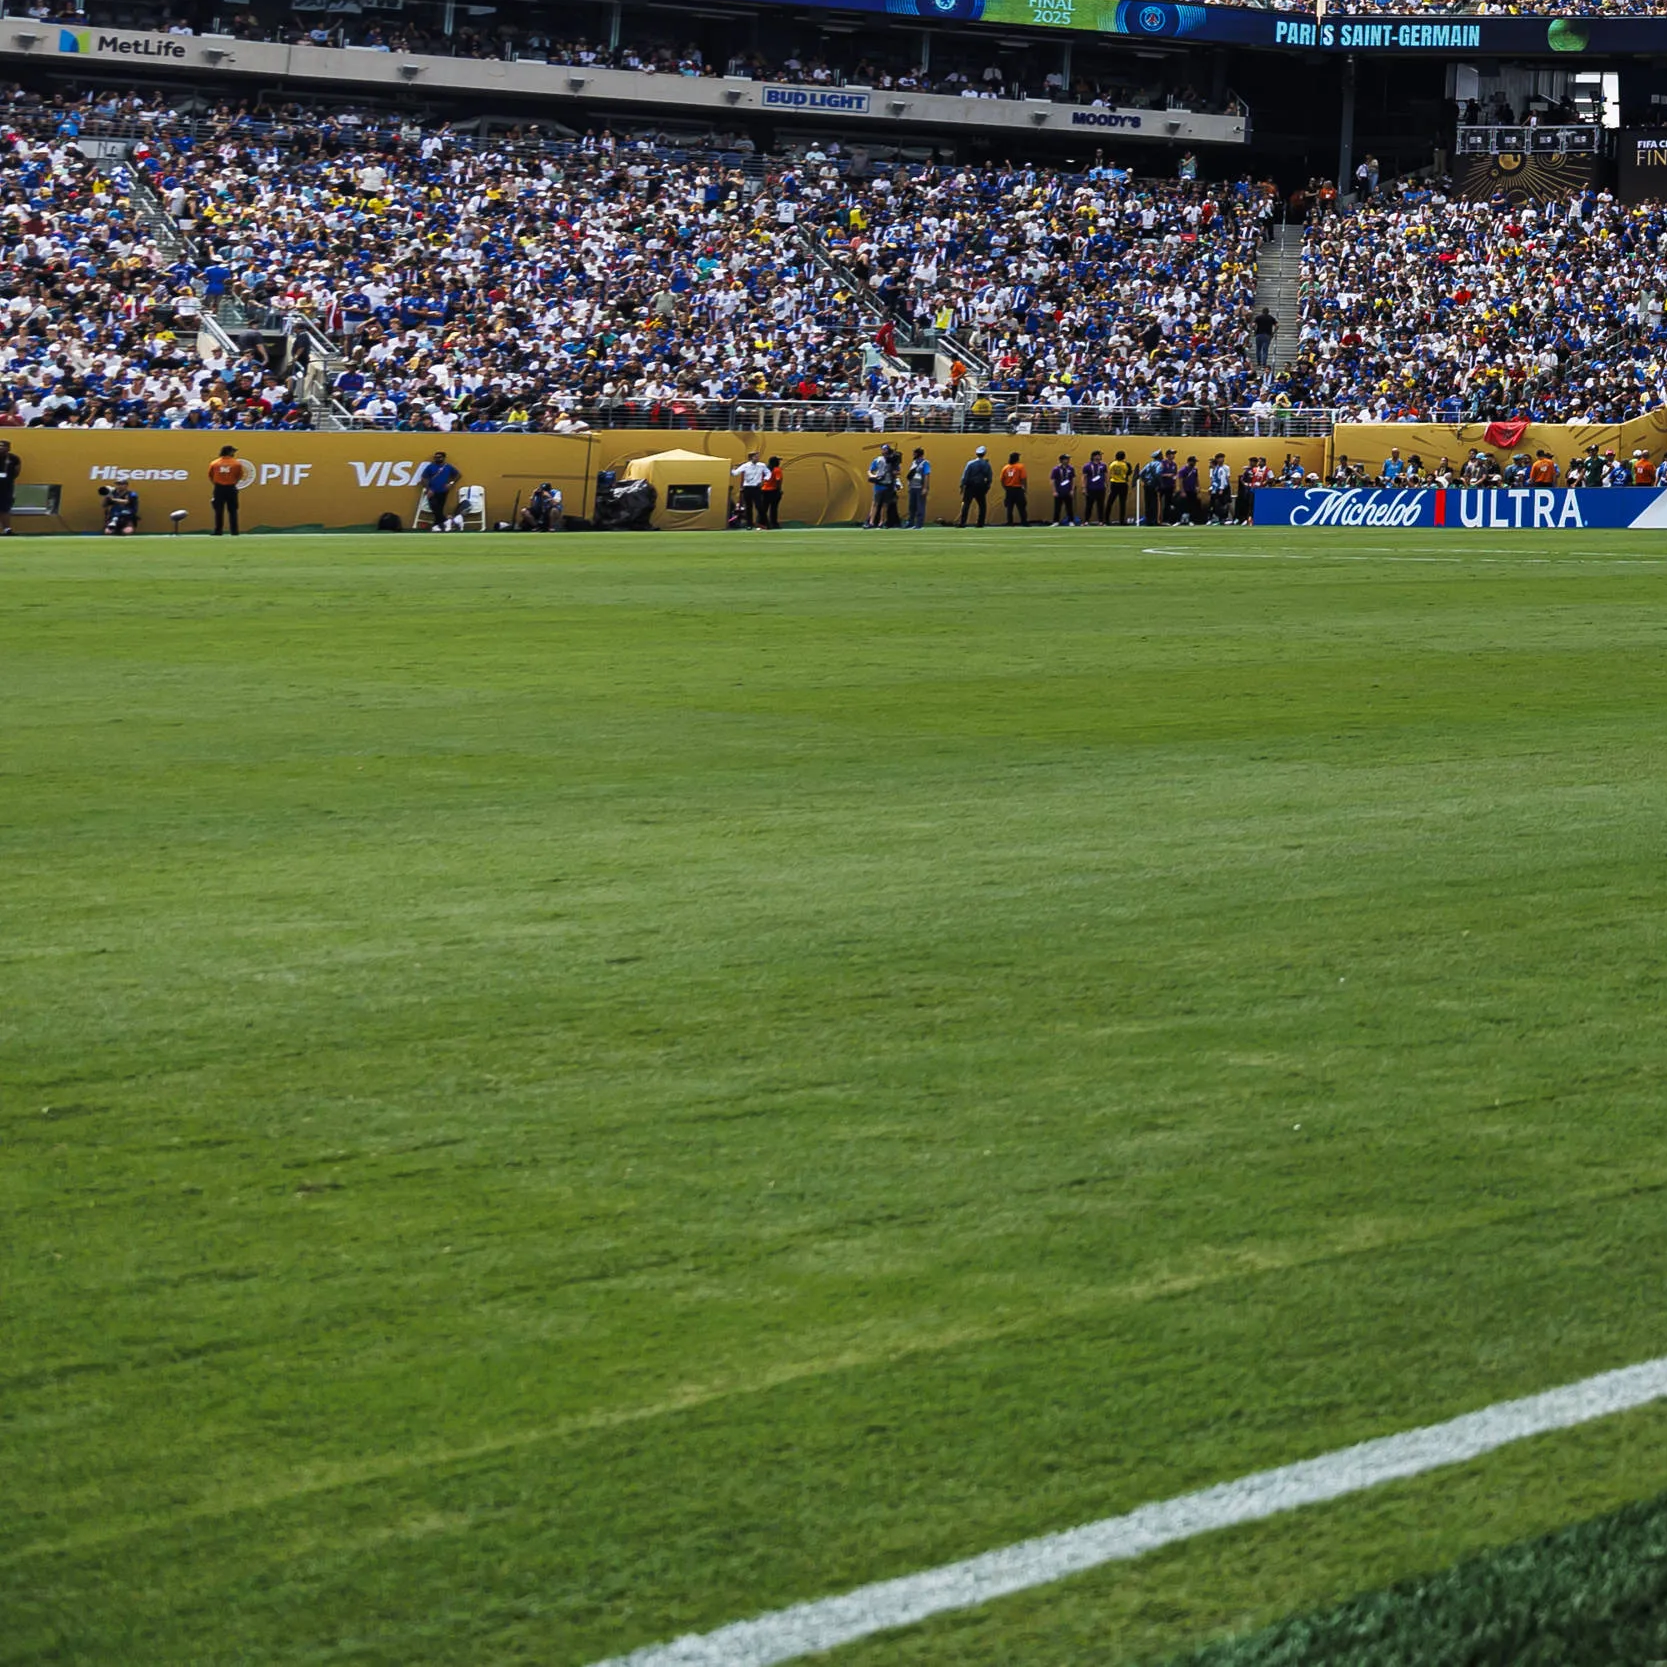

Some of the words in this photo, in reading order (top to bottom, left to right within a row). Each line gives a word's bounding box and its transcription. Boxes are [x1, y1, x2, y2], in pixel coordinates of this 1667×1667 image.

[1032, 8, 1073, 27] 2025
[1275, 21, 1334, 47] PARIS
[1340, 24, 1481, 48] SAINT-GERMAIN
[98, 34, 187, 59] MetLife
[765, 89, 806, 108] BUD
[808, 91, 868, 112] LIGHT
[1072, 110, 1142, 129] MOODY'S
[1637, 140, 1657, 149] FIFA
[89, 465, 189, 481] Hisense
[259, 463, 312, 485] PIF
[1290, 488, 1428, 527] Michelob
[1460, 489, 1584, 528] ULTRA
